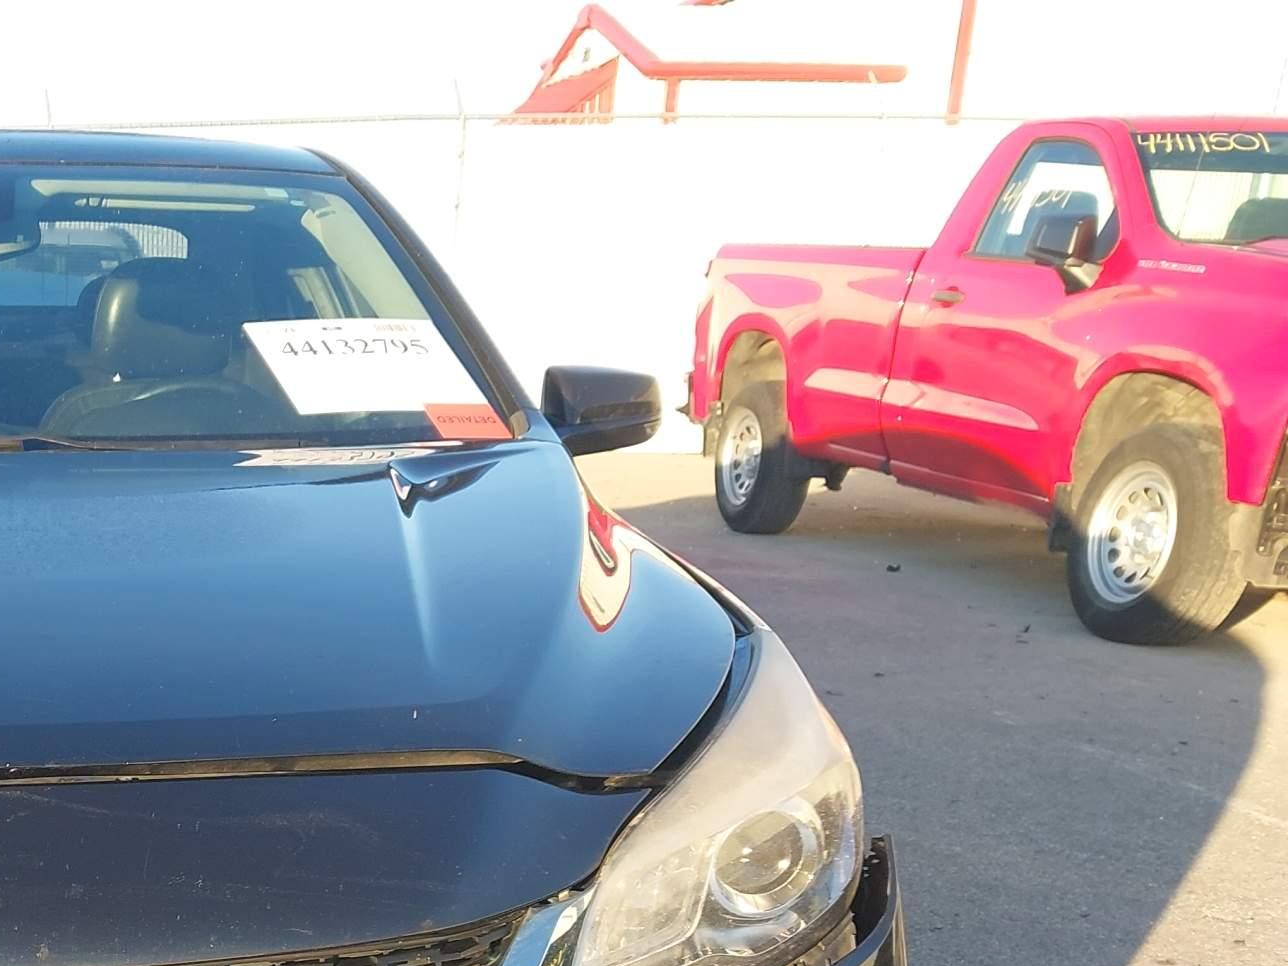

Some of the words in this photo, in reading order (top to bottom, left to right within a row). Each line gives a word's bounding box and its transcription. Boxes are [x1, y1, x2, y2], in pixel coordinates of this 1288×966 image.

[1136, 132, 1271, 154] 44111501
[281, 338, 429, 356] 44132795
[436, 415, 497, 424] DETAILED
